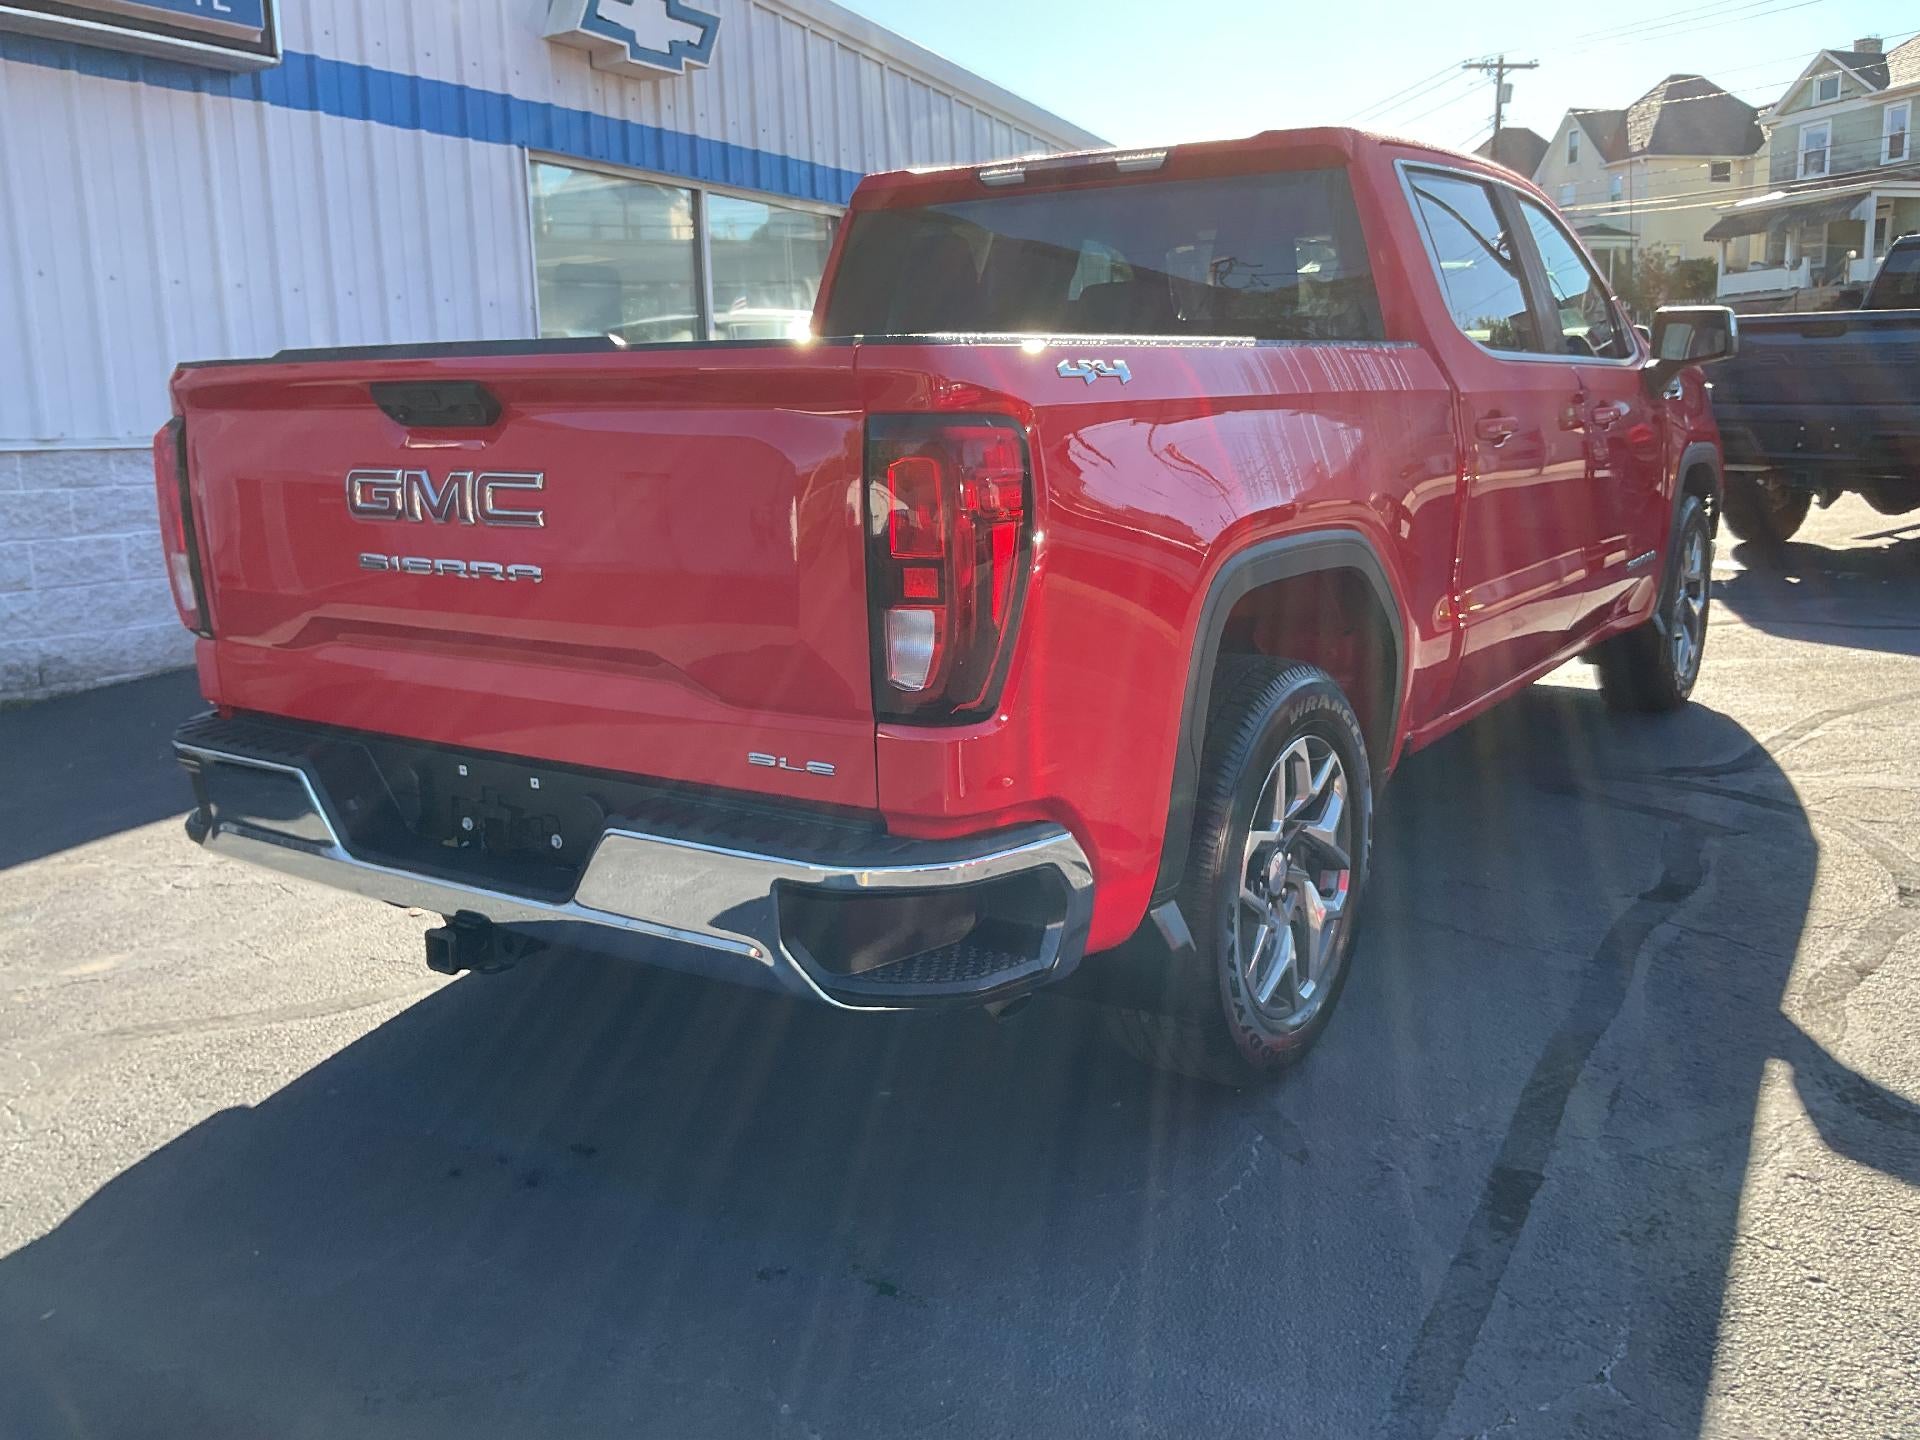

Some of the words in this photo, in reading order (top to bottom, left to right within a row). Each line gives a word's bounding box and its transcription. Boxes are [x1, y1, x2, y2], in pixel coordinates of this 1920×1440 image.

[346, 468, 545, 527] GMC
[359, 552, 544, 584] SIERRA
[747, 751, 835, 776] SLE
